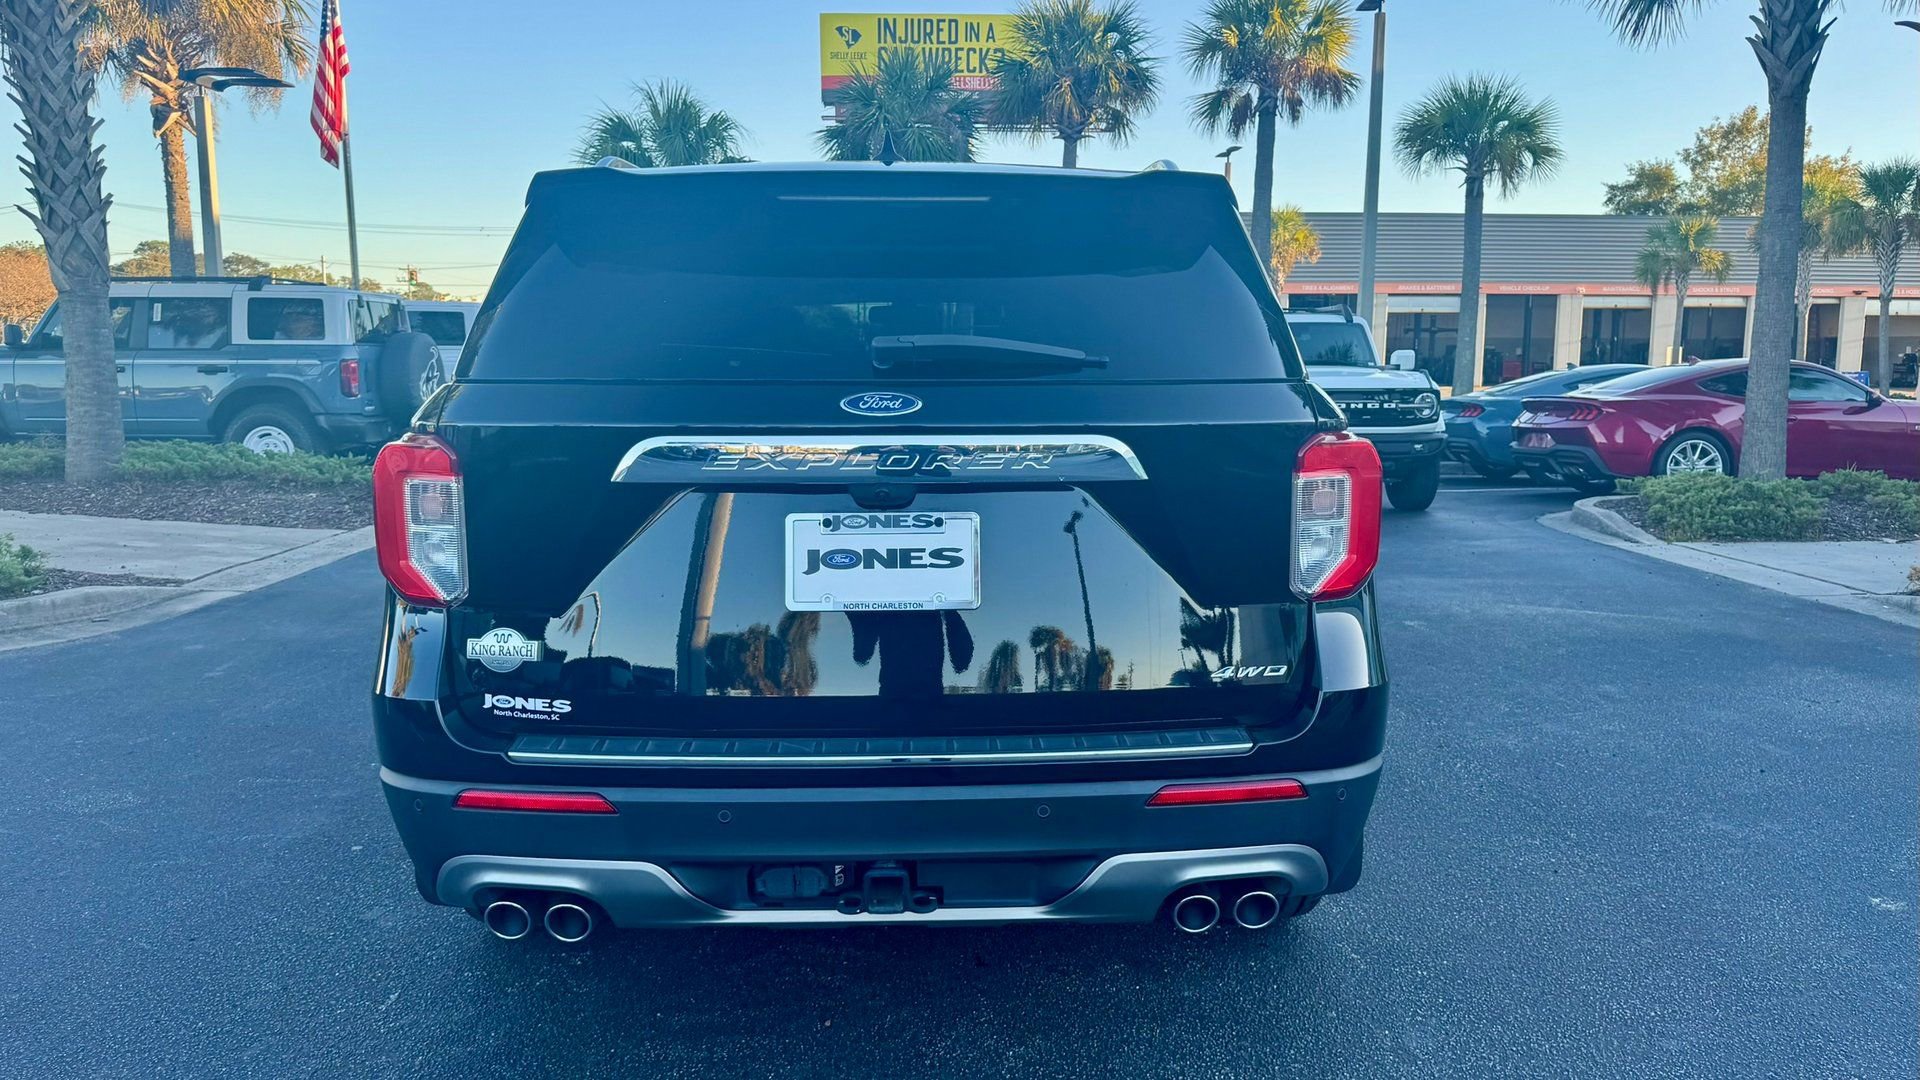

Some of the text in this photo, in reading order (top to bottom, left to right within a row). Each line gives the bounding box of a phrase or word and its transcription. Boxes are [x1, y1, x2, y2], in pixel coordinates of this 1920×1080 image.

[877, 17, 996, 45] INJURED IN A
[830, 51, 849, 60] SHELLY
[858, 395, 904, 409] Ford
[701, 452, 1054, 471] EXPLORER
[829, 514, 935, 532] JONES
[802, 547, 965, 575] JONES
[843, 602, 924, 610] NORTH CHARLESTON
[470, 642, 534, 658] KING RANCH
[1210, 665, 1288, 678] 4WD
[482, 693, 572, 713] JONES
[493, 709, 560, 721] North Charleston, SC
